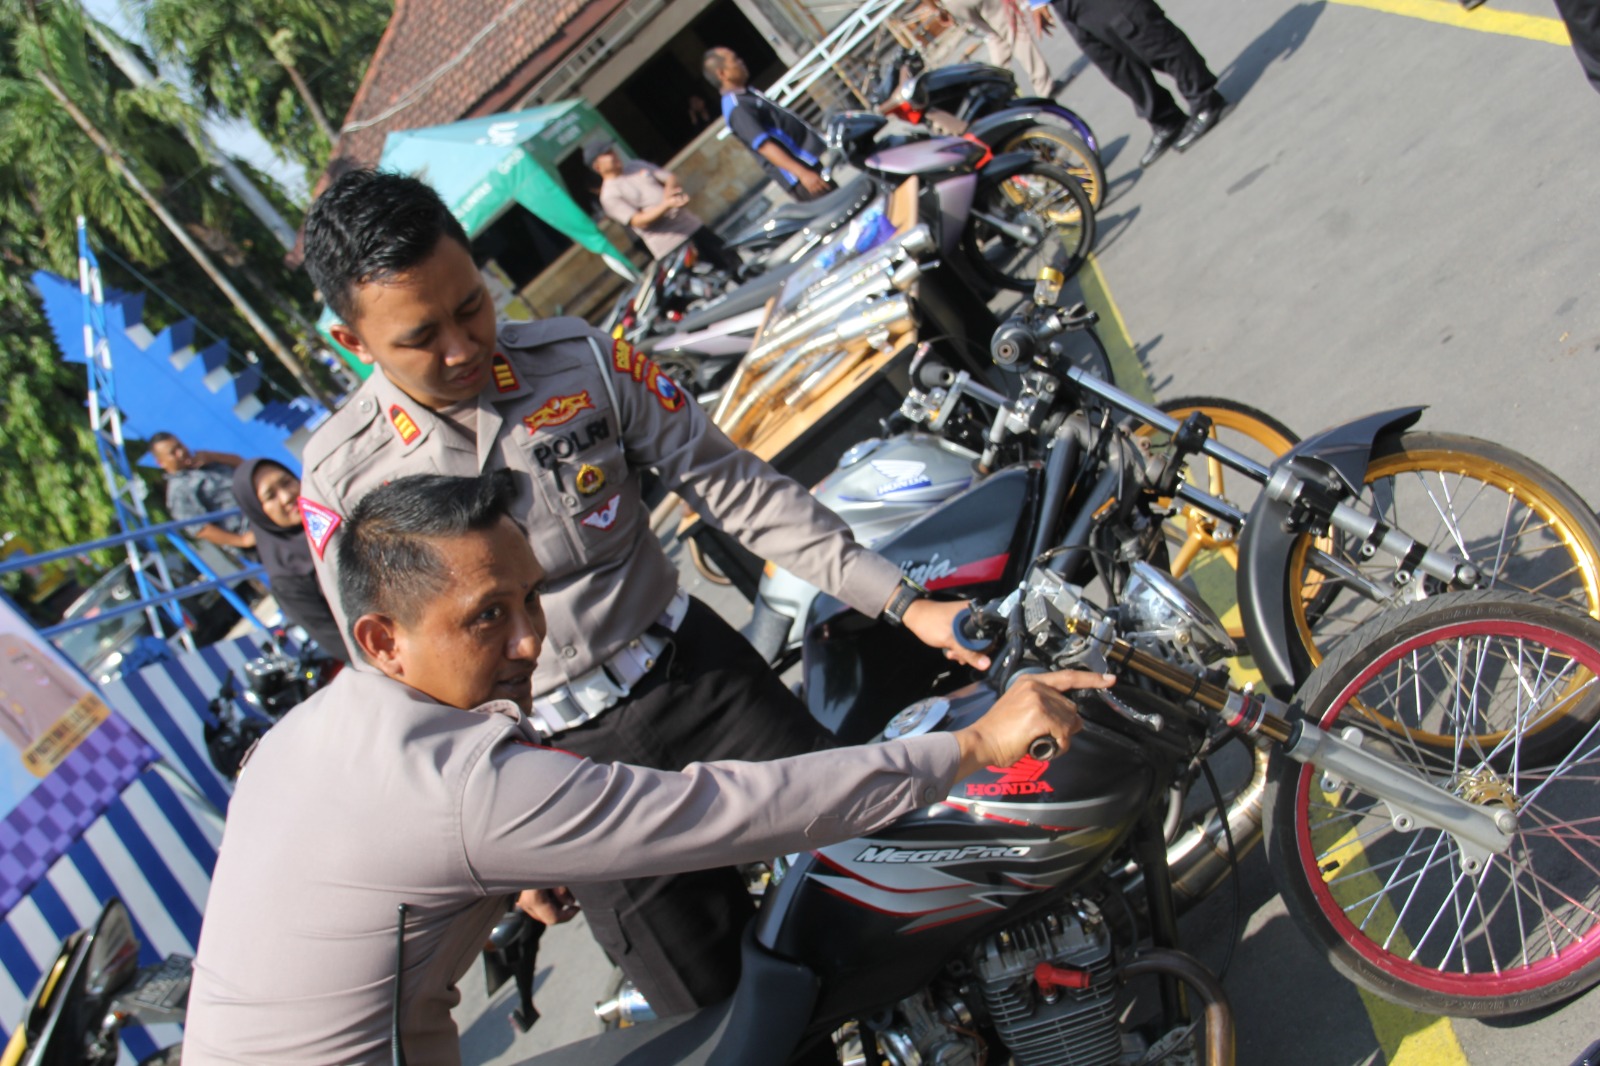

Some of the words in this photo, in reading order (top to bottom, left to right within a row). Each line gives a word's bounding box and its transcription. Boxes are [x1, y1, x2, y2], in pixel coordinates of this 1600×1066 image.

[533, 417, 610, 470] POLRI
[878, 474, 931, 495] HONDA
[900, 552, 958, 588] inja
[965, 780, 1054, 797] HONDA
